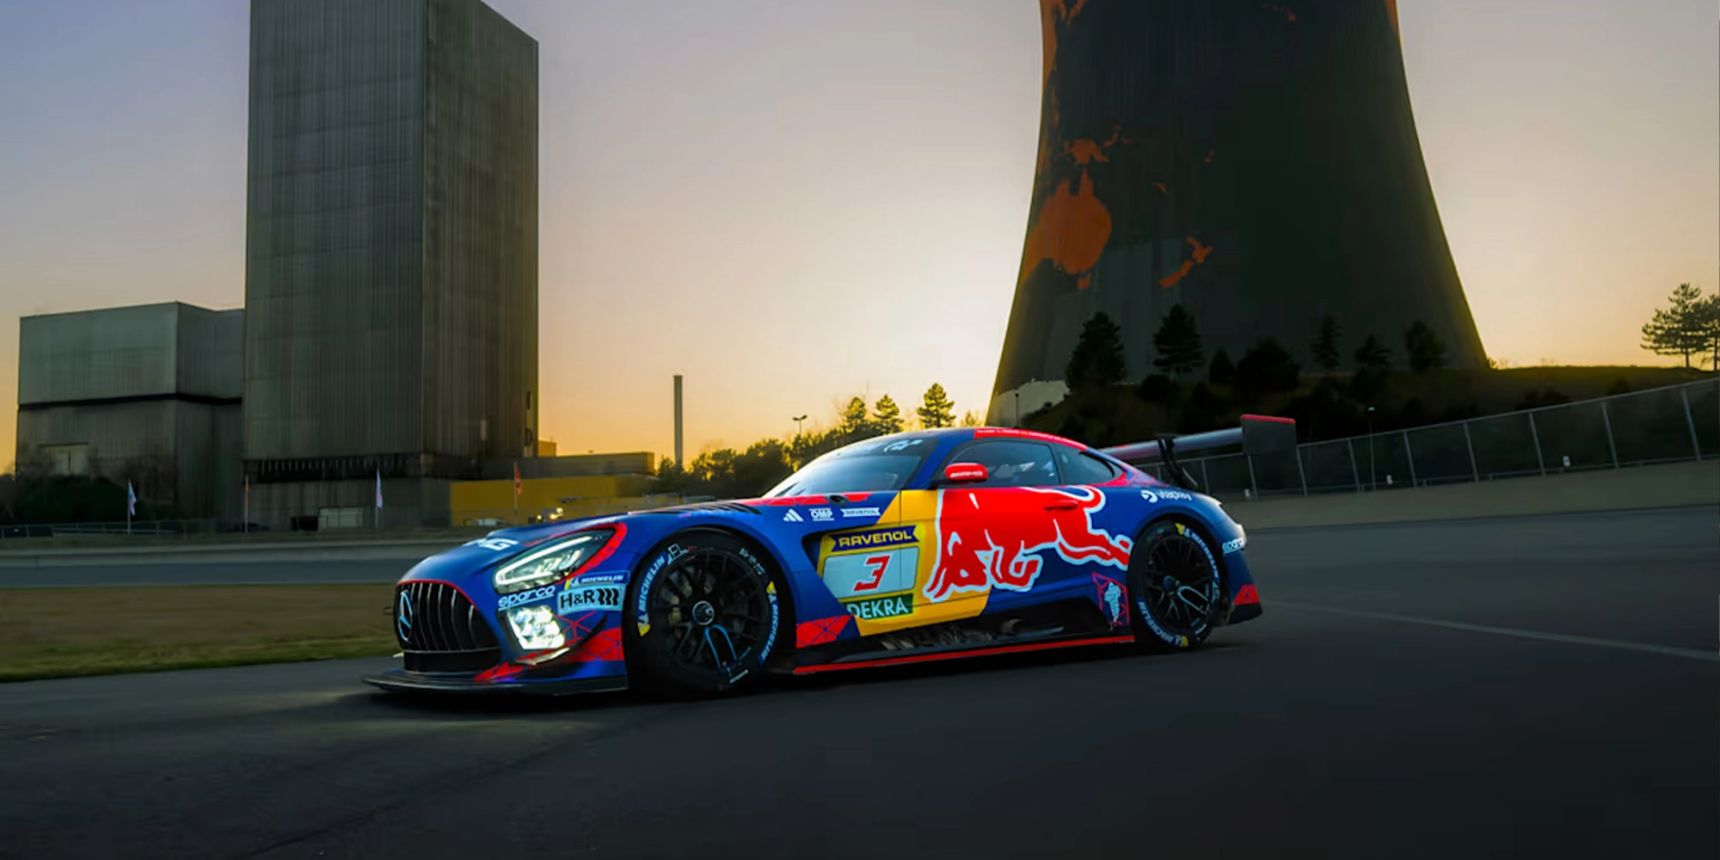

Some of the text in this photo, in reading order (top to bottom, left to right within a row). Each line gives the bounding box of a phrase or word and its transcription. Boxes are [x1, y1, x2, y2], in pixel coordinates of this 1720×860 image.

[839, 530, 912, 547] RAVENOL
[638, 555, 666, 612] MICHELIN
[853, 554, 891, 592] 3
[498, 585, 556, 608] sparco
[559, 589, 596, 609] H&R
[846, 597, 909, 619] DEKRA
